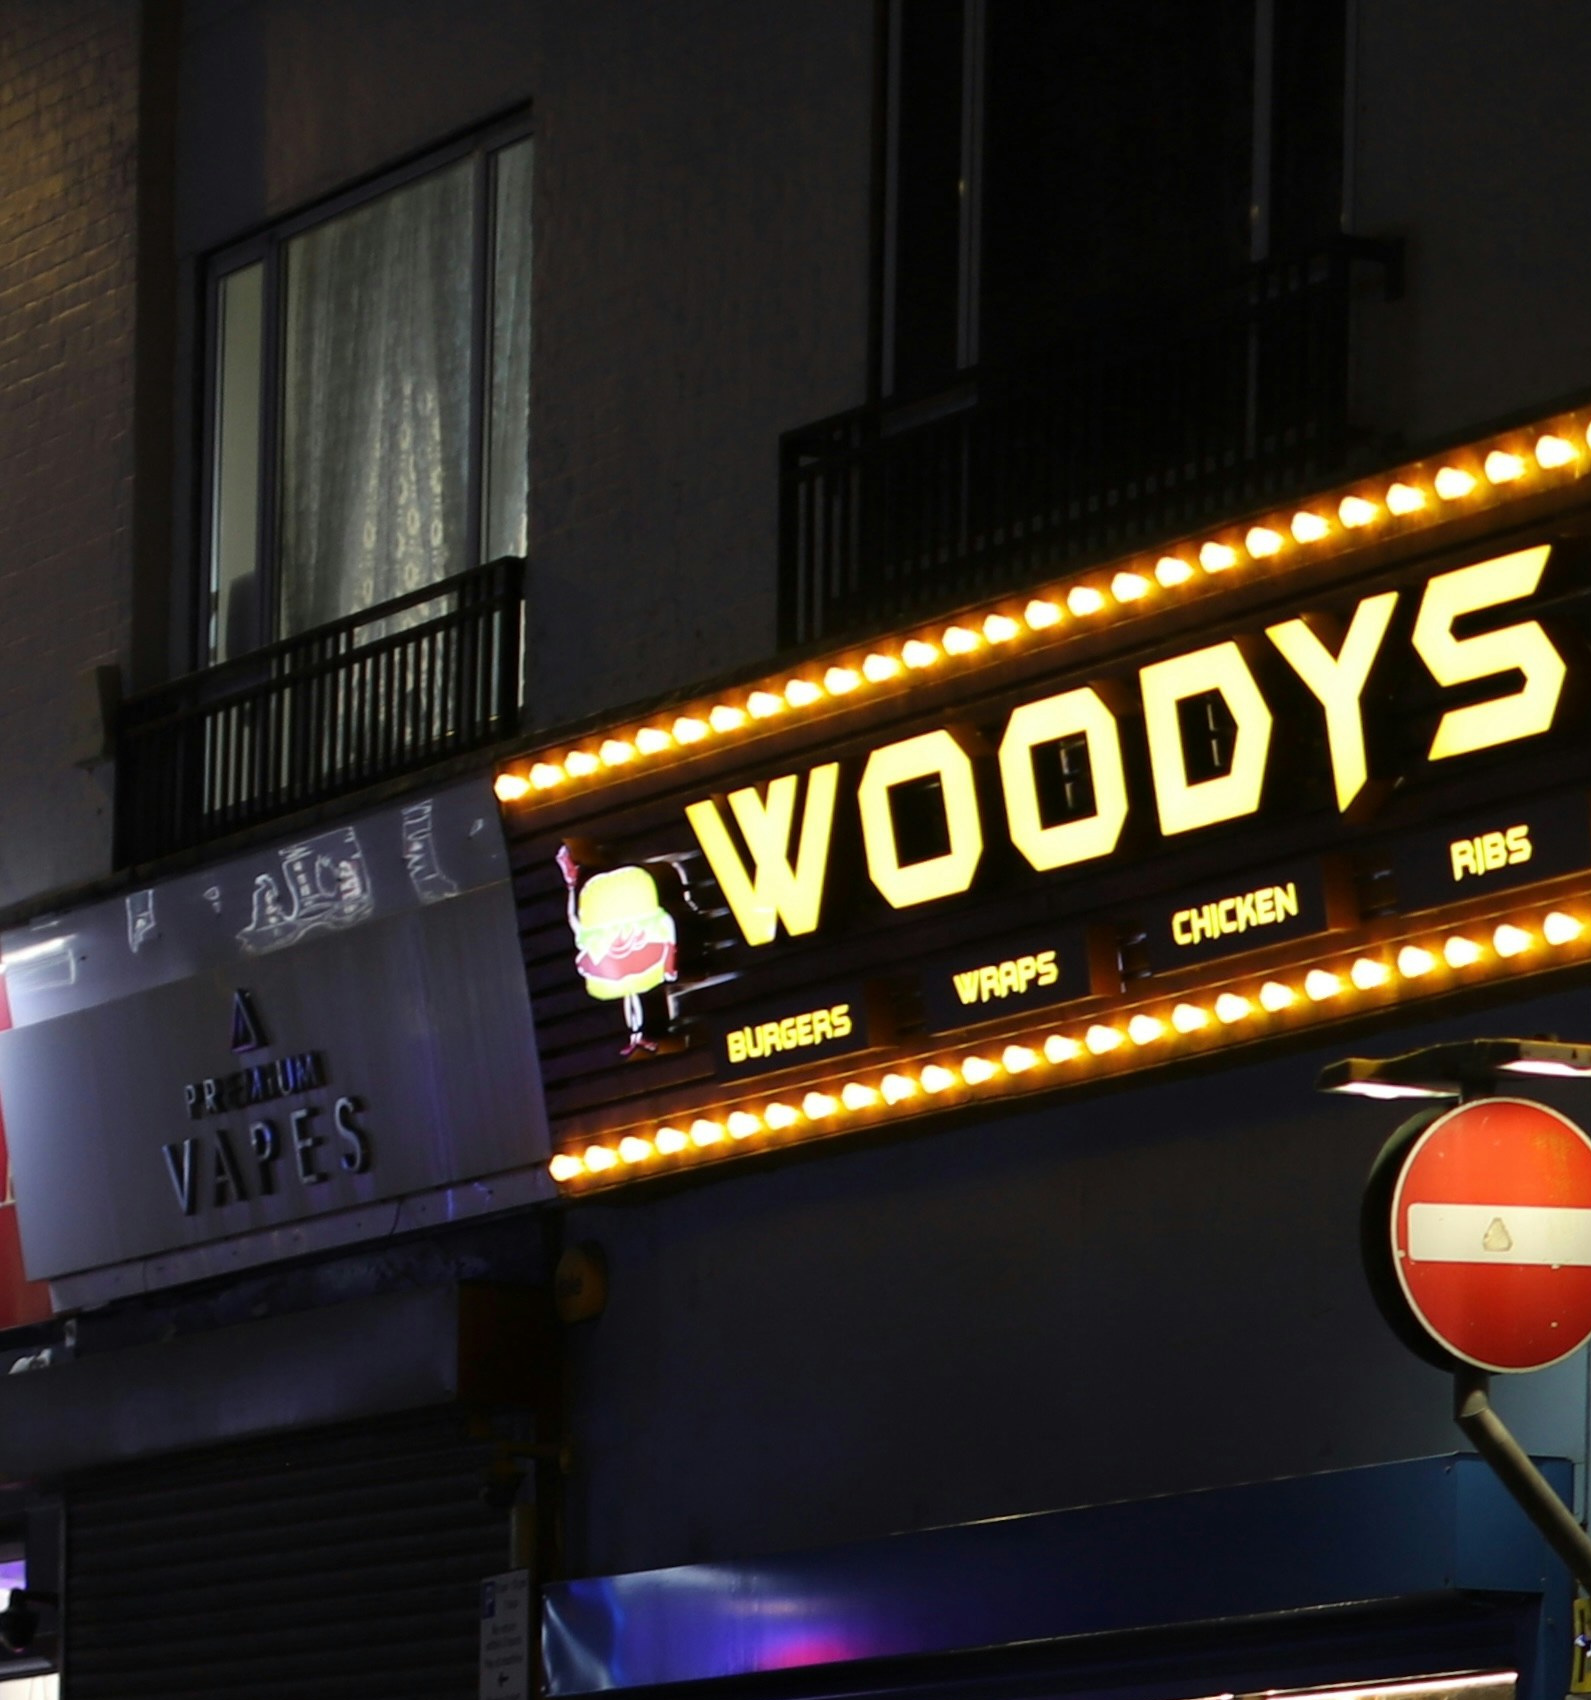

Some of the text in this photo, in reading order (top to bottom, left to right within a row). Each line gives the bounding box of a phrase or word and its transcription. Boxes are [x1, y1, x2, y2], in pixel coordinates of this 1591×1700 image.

[685, 543, 1568, 947] WOODYS
[1450, 826, 1532, 882] RIBS
[1172, 883, 1299, 947] CHICKEN
[952, 949, 1059, 1005] WRAPS
[726, 1004, 852, 1063] BURGERS
[161, 1095, 372, 1216] VAPES
